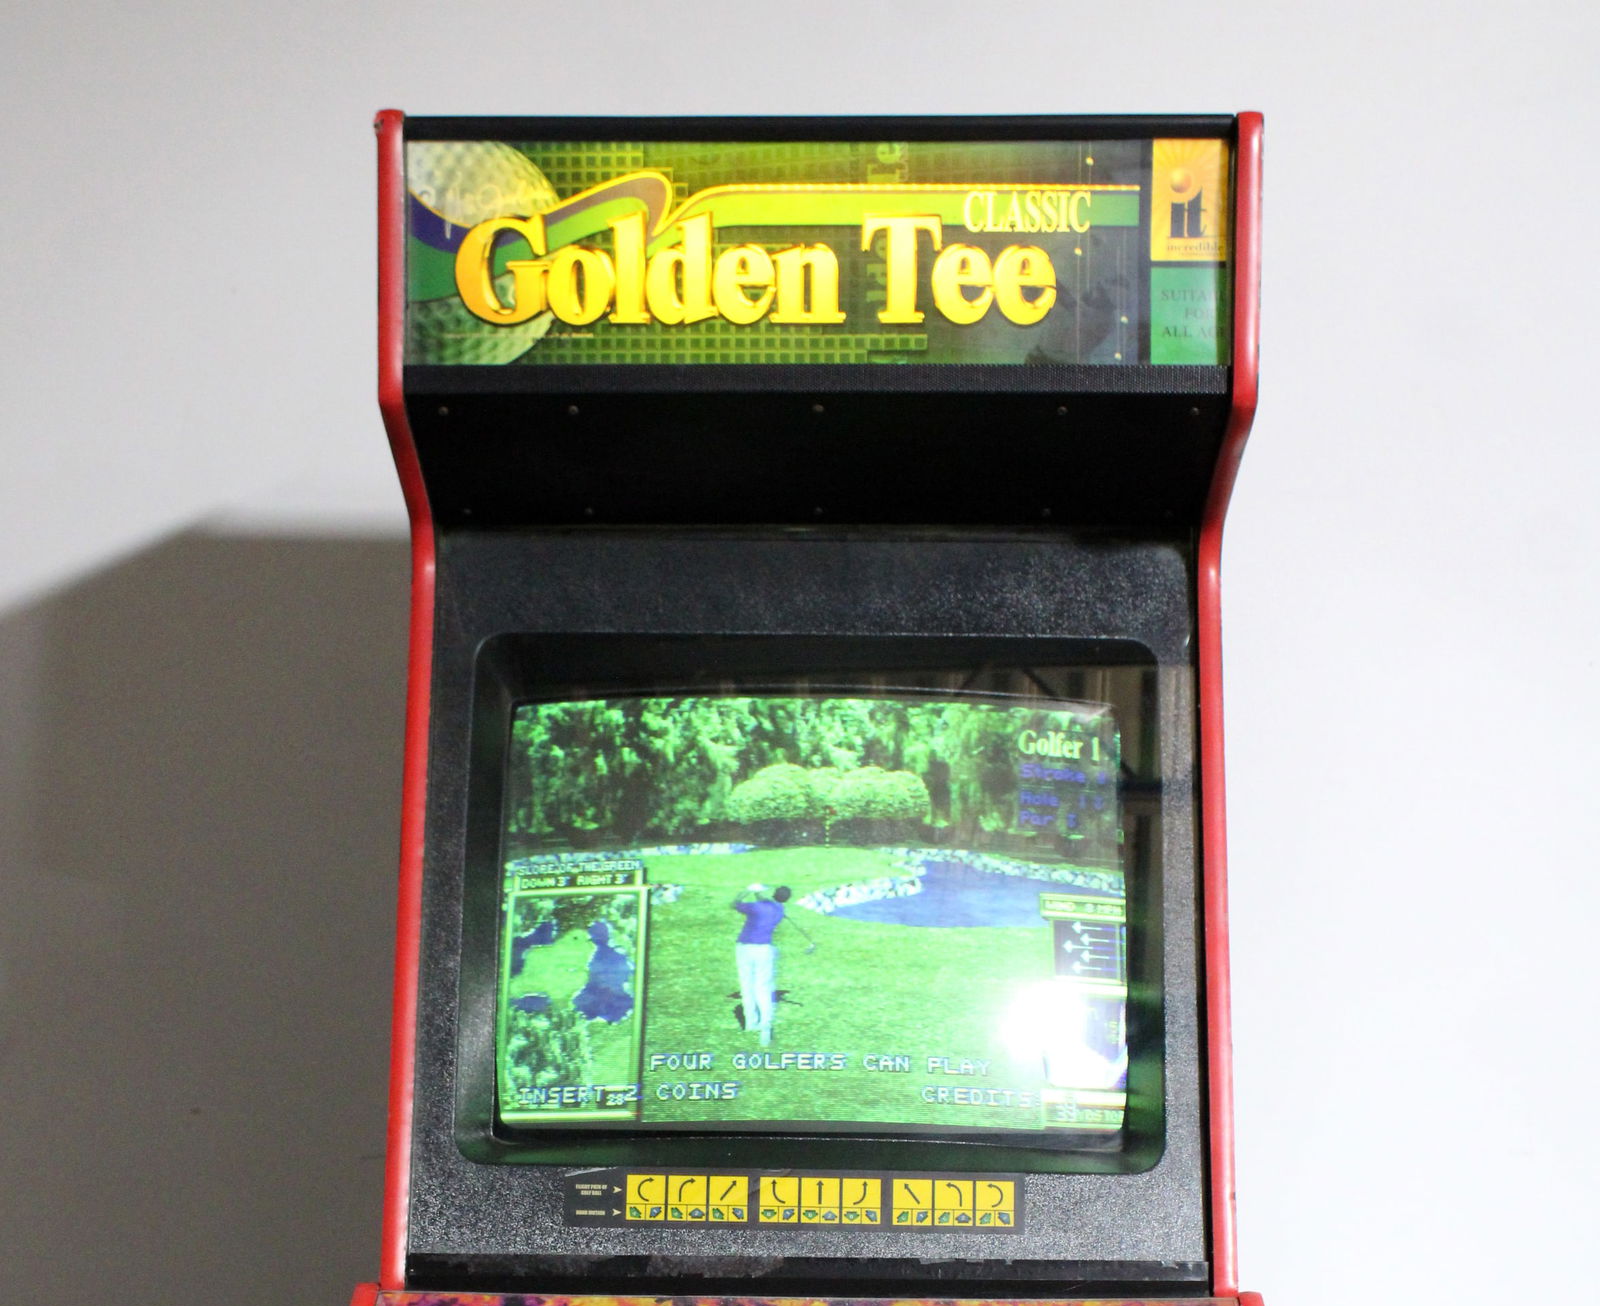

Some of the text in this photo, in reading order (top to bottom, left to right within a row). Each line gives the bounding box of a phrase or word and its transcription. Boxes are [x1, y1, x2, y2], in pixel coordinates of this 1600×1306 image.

[963, 190, 1092, 233] CLASSIC
[455, 211, 847, 326] Golden
[860, 212, 1057, 326] Tee
[1018, 729, 1100, 762] Golfer 1
[1020, 810, 1054, 826] Par
[650, 1053, 992, 1076] FOUR GOLFERS CAN PLAY
[518, 1085, 601, 1105] INSERT
[655, 1083, 738, 1100] COINS
